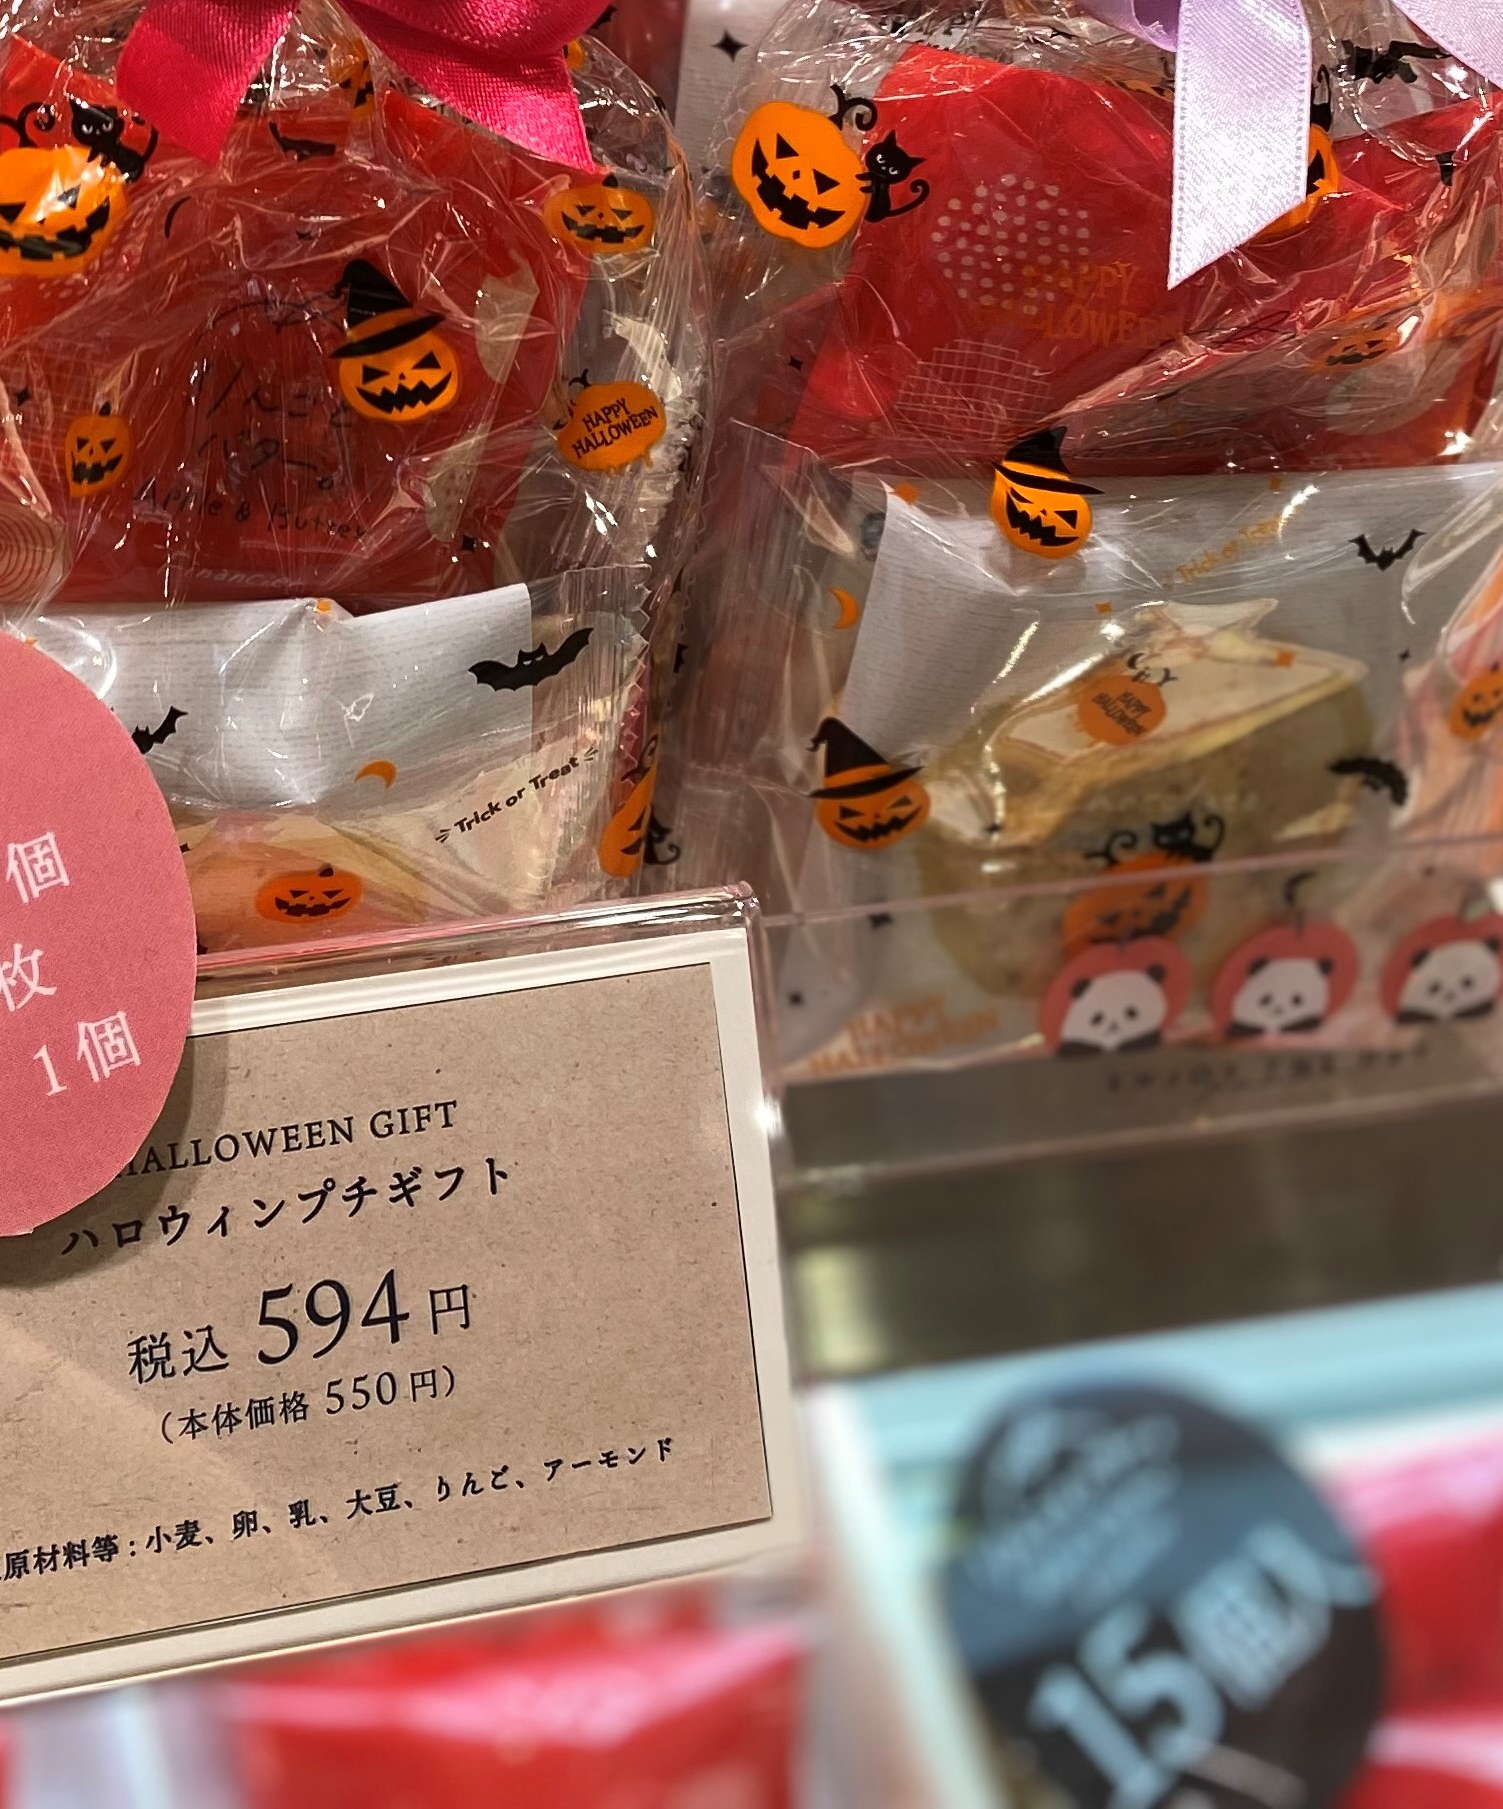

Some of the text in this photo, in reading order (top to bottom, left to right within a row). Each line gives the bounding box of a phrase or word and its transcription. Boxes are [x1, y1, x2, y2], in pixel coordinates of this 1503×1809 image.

[571, 406, 659, 459] HALLOWEEN
[582, 397, 630, 432] HAPPY
[453, 756, 580, 834] Trick or Treat
[32, 1009, 143, 1098] 1個
[369, 1099, 458, 1139] GIFT
[60, 1156, 510, 1256] ハロウィンプチギフト
[256, 1268, 410, 1366] 594
[325, 1371, 397, 1416] 550
